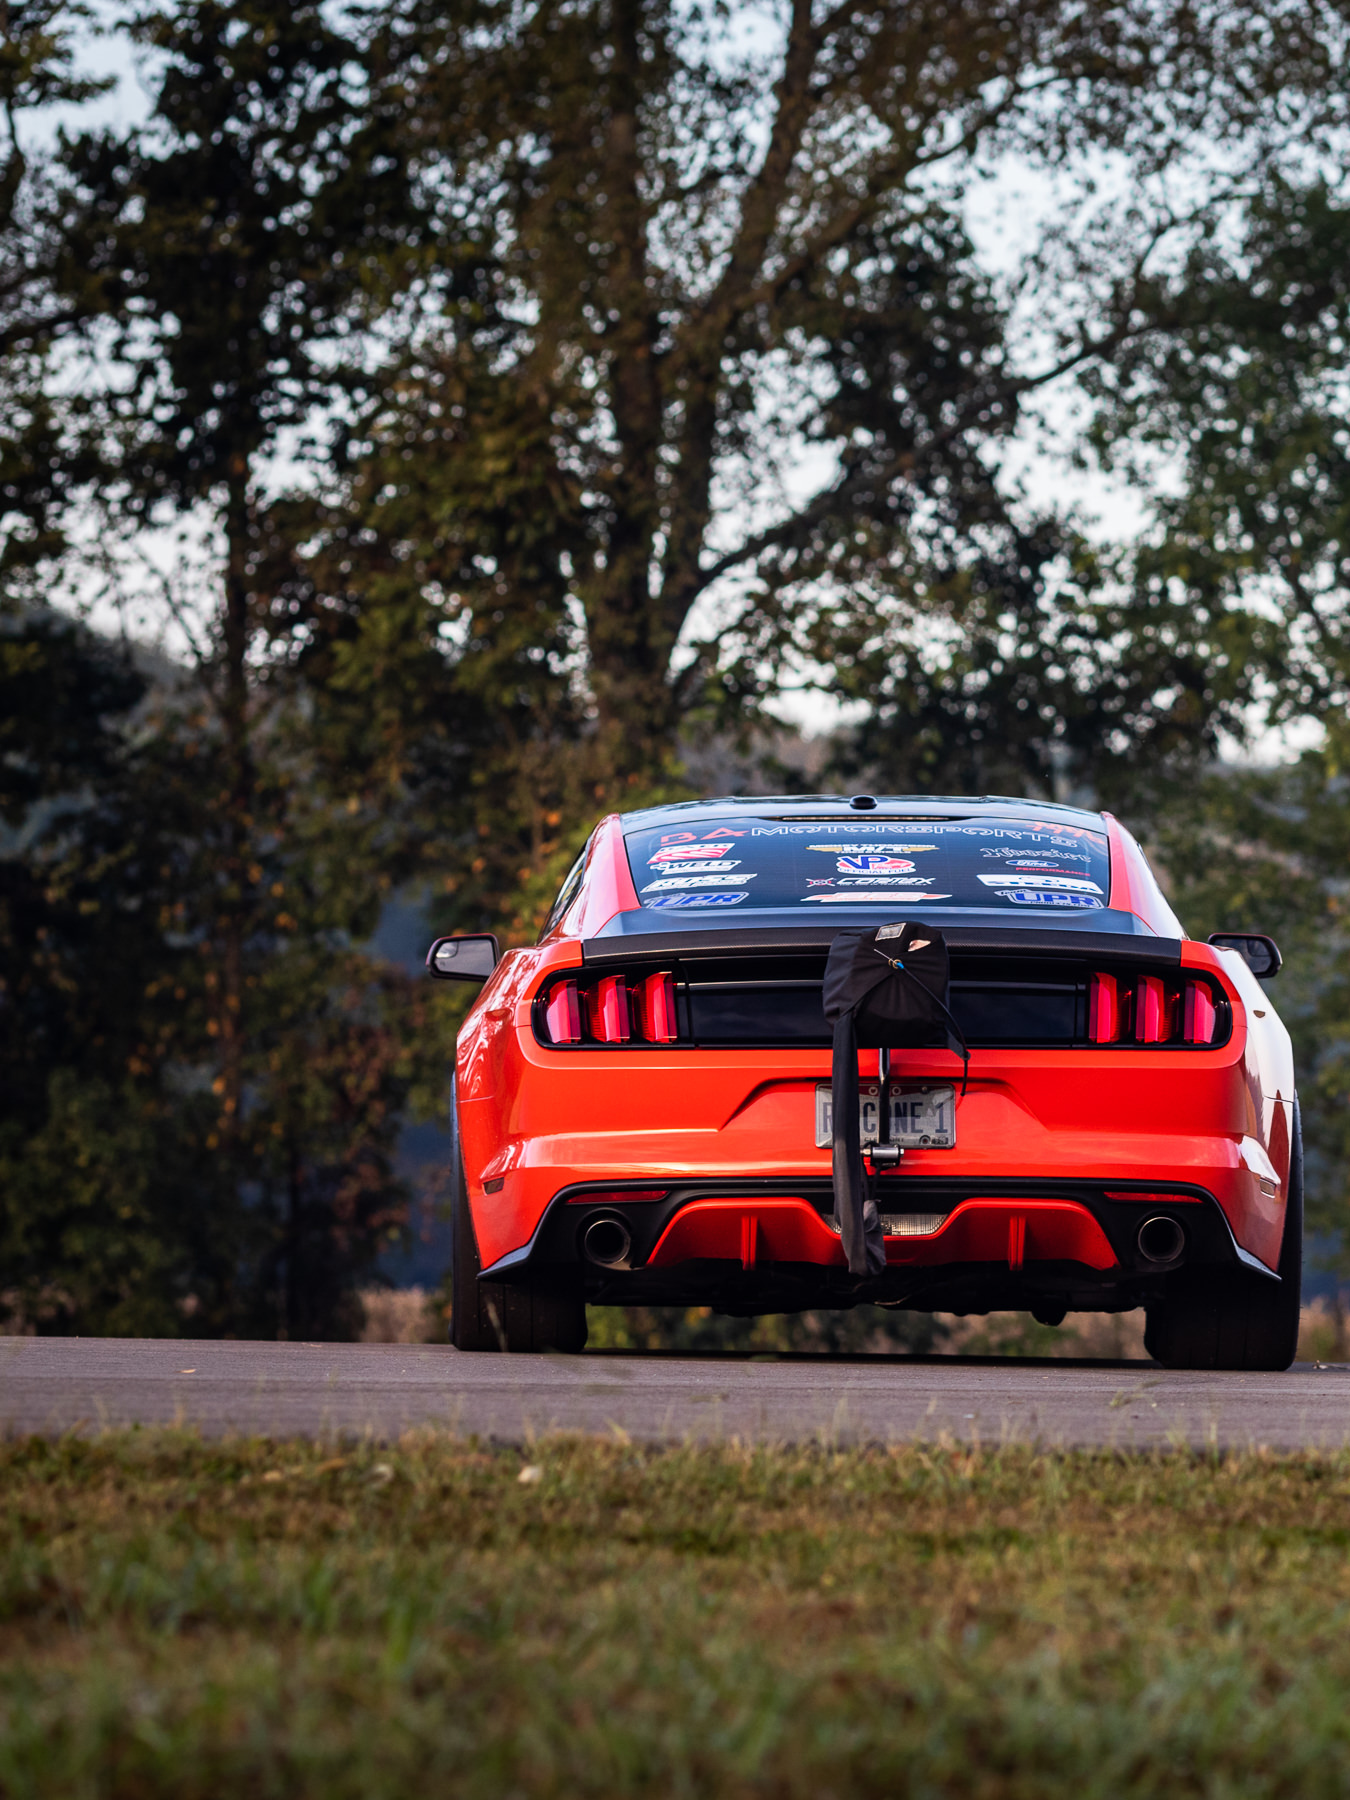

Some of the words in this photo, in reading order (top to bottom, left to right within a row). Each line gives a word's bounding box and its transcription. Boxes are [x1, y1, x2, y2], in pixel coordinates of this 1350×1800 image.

[751, 825, 1078, 848] MOTORSPORTS
[979, 847, 1092, 863] Hoosier
[668, 861, 736, 869] WELD
[840, 855, 889, 870] VP
[1015, 867, 1091, 877] PERFORMANCE
[653, 894, 741, 908] UPR
[1014, 893, 1096, 907] UPR
[934, 1102, 948, 1134] 1
